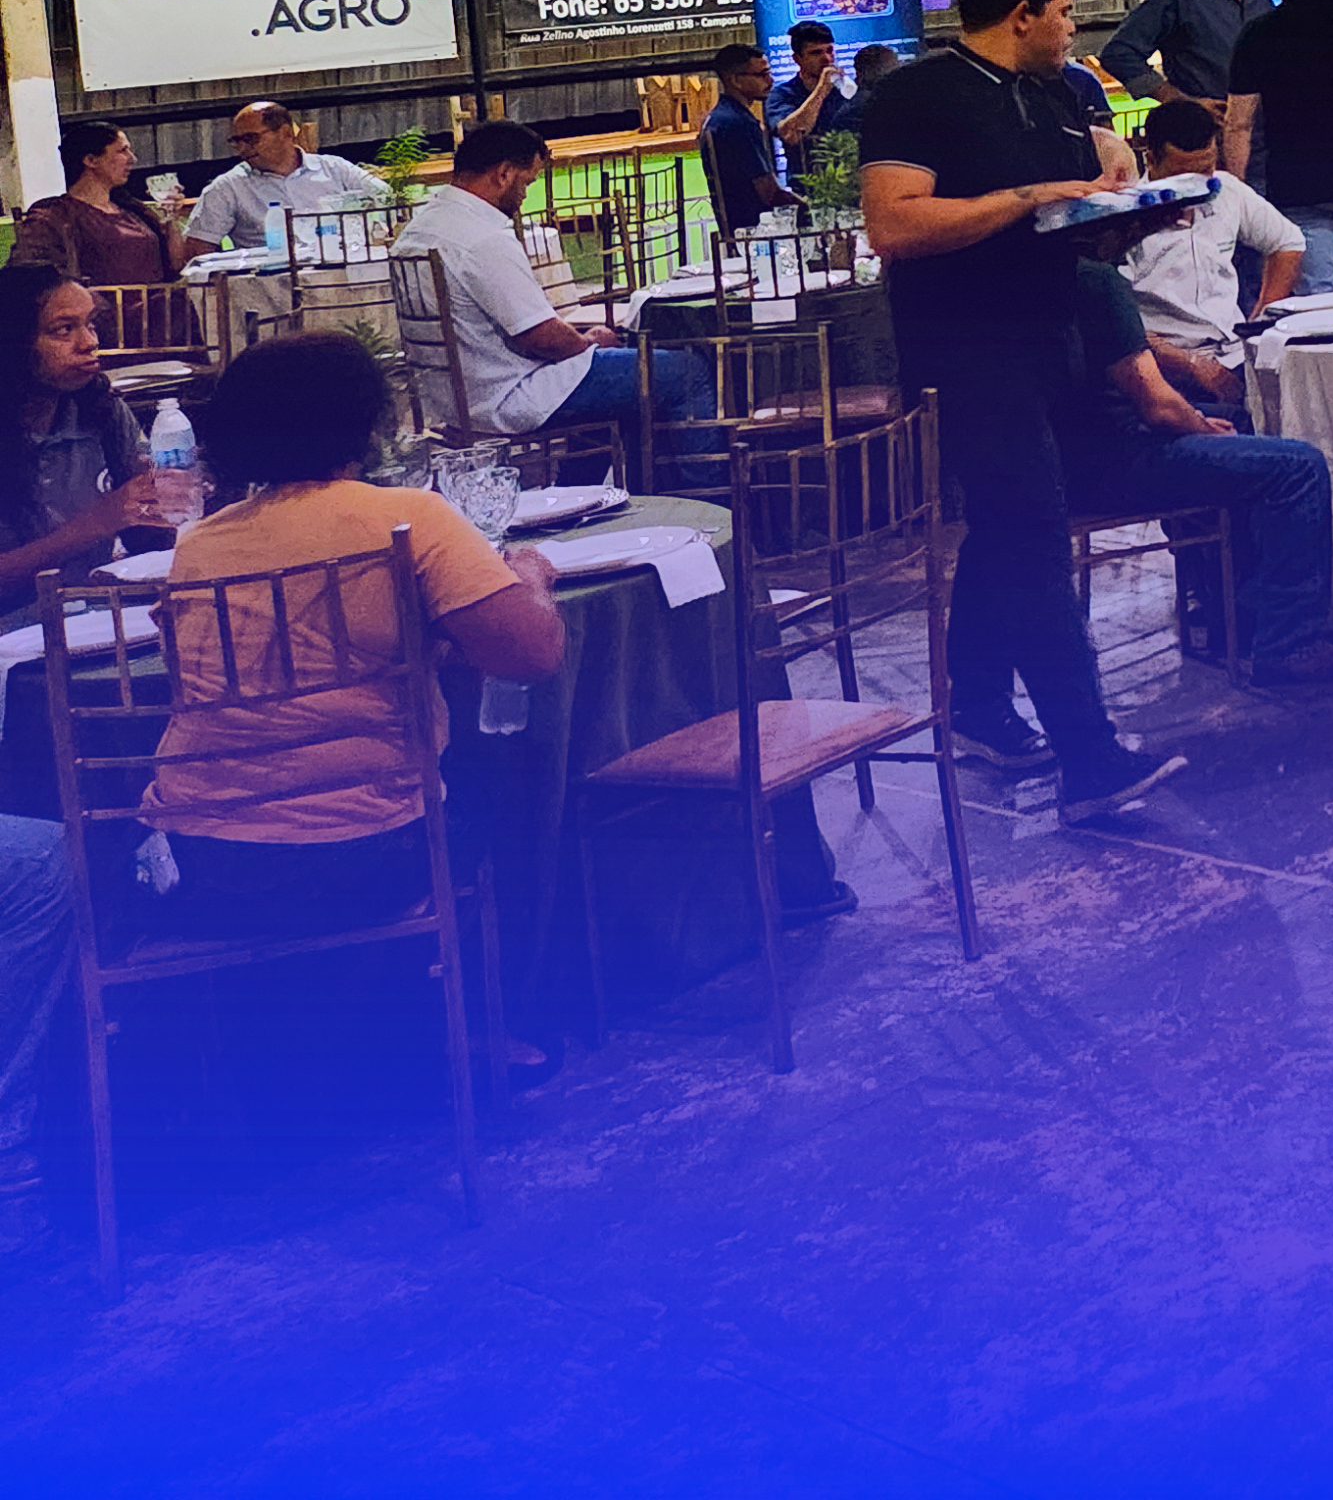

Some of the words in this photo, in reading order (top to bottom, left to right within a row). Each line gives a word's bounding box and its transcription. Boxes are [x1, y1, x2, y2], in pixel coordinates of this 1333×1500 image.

[576, 26, 625, 40] Agostinho
[627, 22, 675, 35] Lorenzetti
[677, 20, 694, 29] 158
[701, 16, 737, 28] Campos
